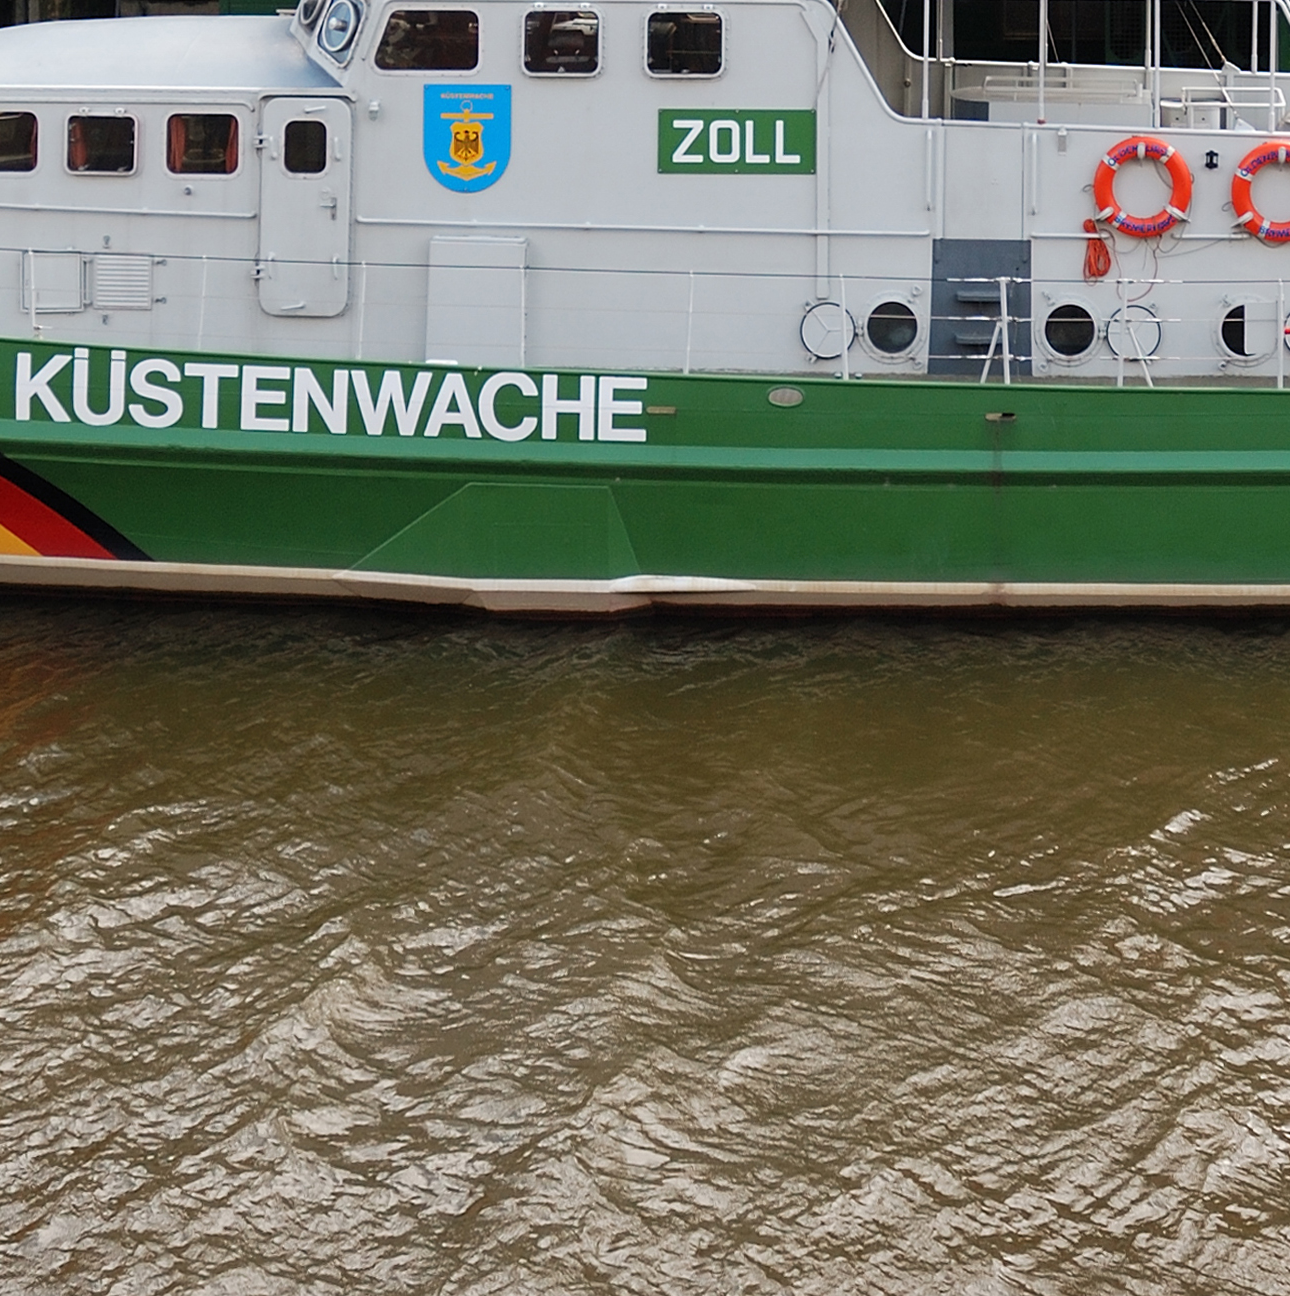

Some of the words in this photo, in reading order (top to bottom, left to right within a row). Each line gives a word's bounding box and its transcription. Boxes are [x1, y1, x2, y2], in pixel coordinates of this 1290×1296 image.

[670, 119, 801, 165] ZOLL
[1107, 144, 1168, 166] OLDENURG
[13, 347, 649, 444] KÜSTENWACHE
